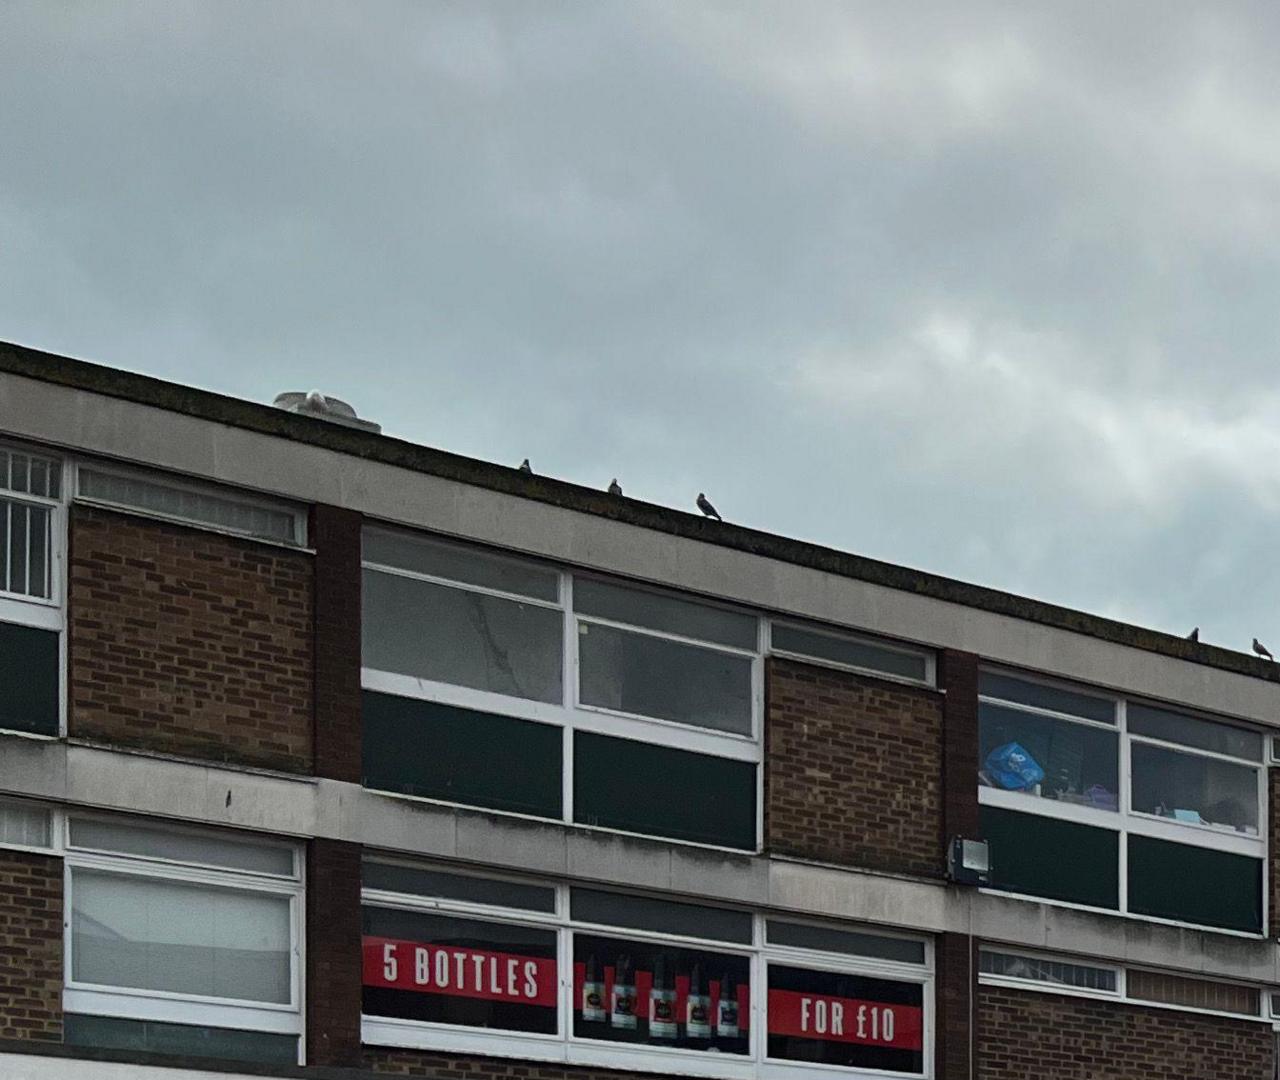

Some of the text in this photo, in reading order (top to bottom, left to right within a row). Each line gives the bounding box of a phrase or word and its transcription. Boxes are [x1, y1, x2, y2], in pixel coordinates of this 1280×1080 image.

[382, 944, 894, 1042] 5 BOTTLES FOR £10
